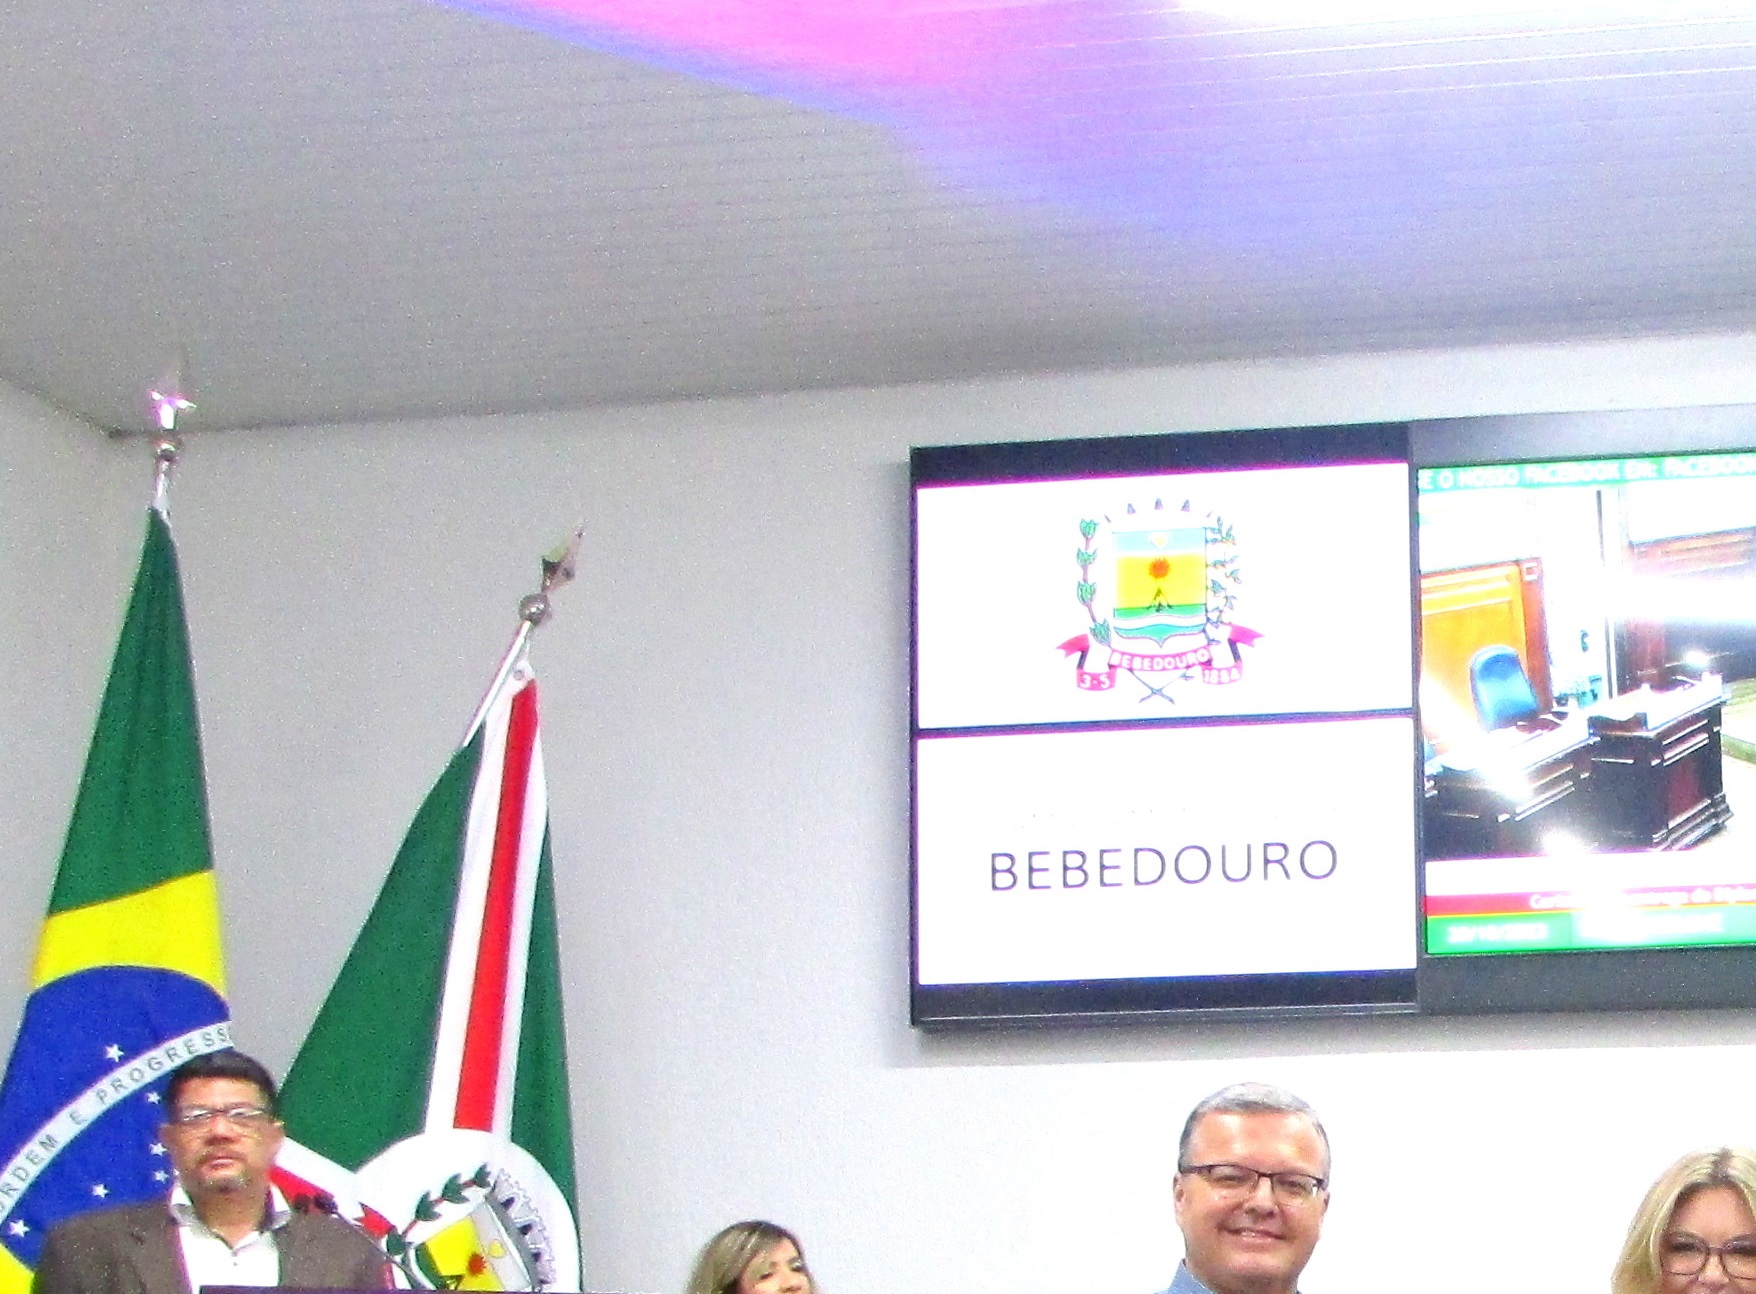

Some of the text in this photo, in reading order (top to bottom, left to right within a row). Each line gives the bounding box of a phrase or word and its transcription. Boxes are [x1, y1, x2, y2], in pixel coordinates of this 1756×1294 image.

[1524, 462, 1619, 484] FACEBOOK
[1110, 647, 1210, 671] BEBEDOURO
[991, 839, 1338, 892] BEBEDOURO
[69, 1110, 88, 1126] E
[96, 1027, 231, 1105] PROGRESS
